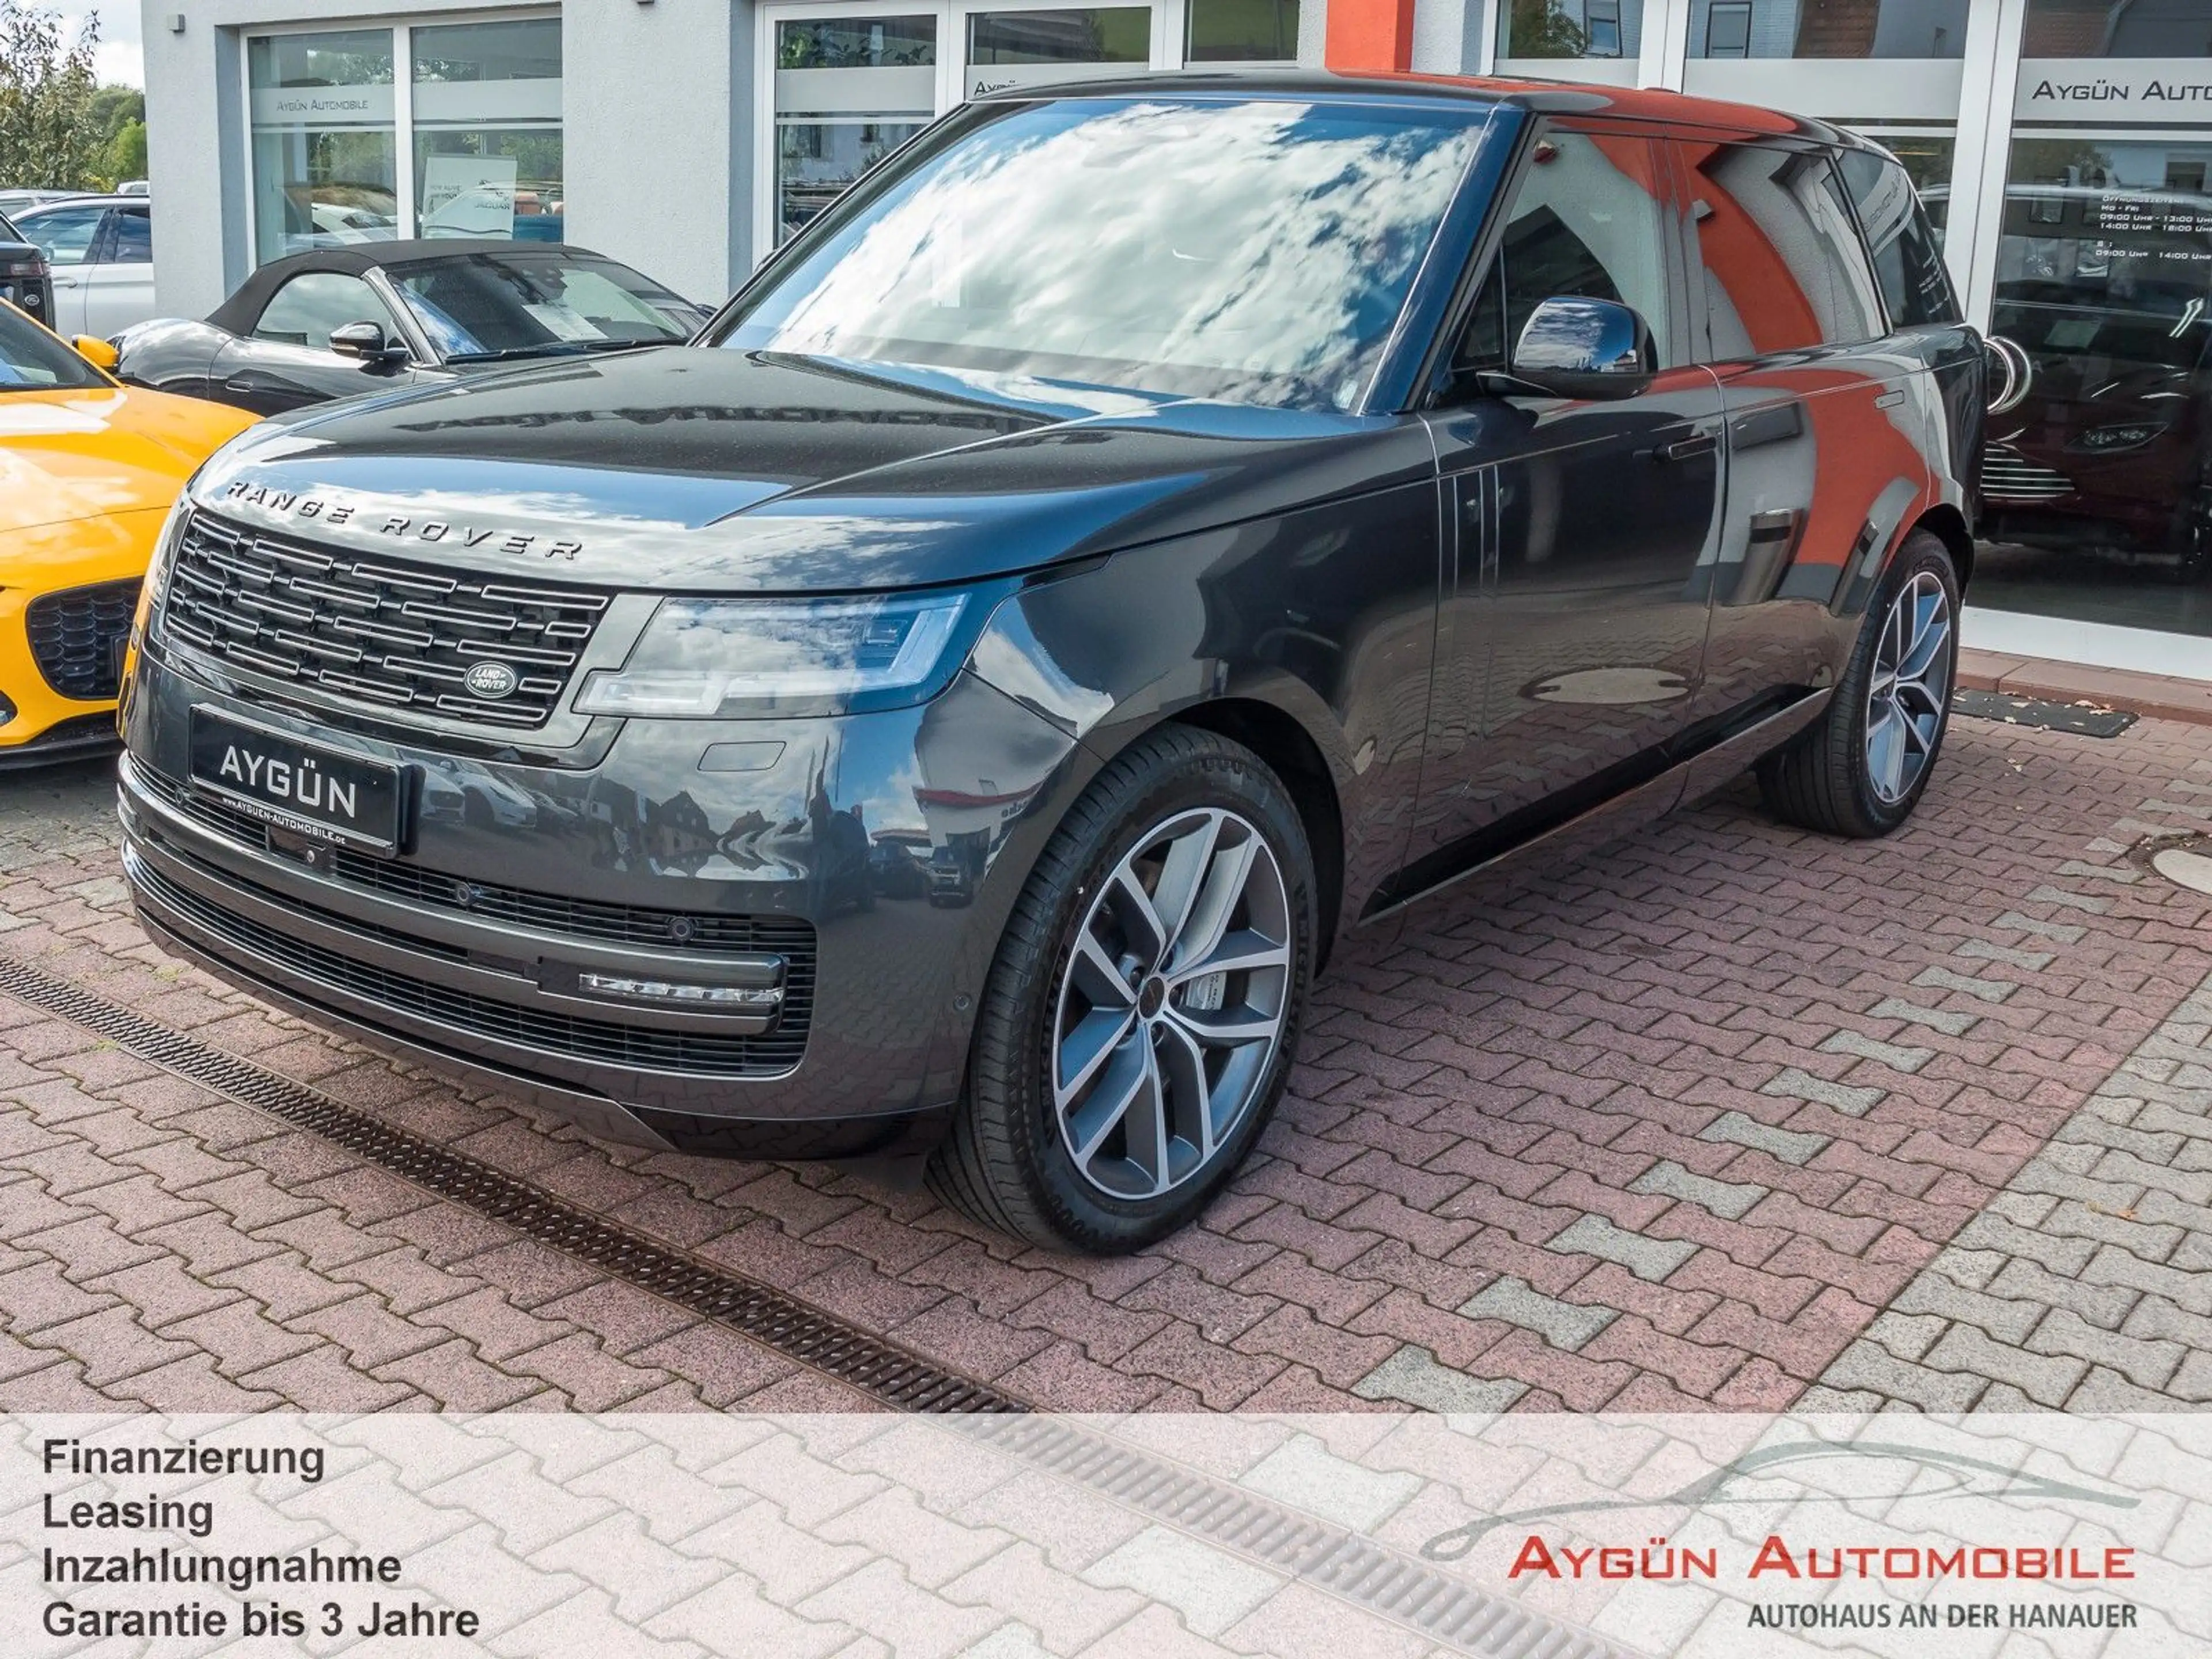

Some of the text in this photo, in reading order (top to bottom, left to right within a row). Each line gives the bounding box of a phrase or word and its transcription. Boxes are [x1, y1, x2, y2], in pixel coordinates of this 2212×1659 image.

[2032, 79, 2129, 100] AYGÜN
[227, 482, 583, 561] RANGE ROVER
[475, 669, 501, 679] LAND
[475, 679, 507, 690] ROVER
[219, 745, 356, 819] AYGÜN
